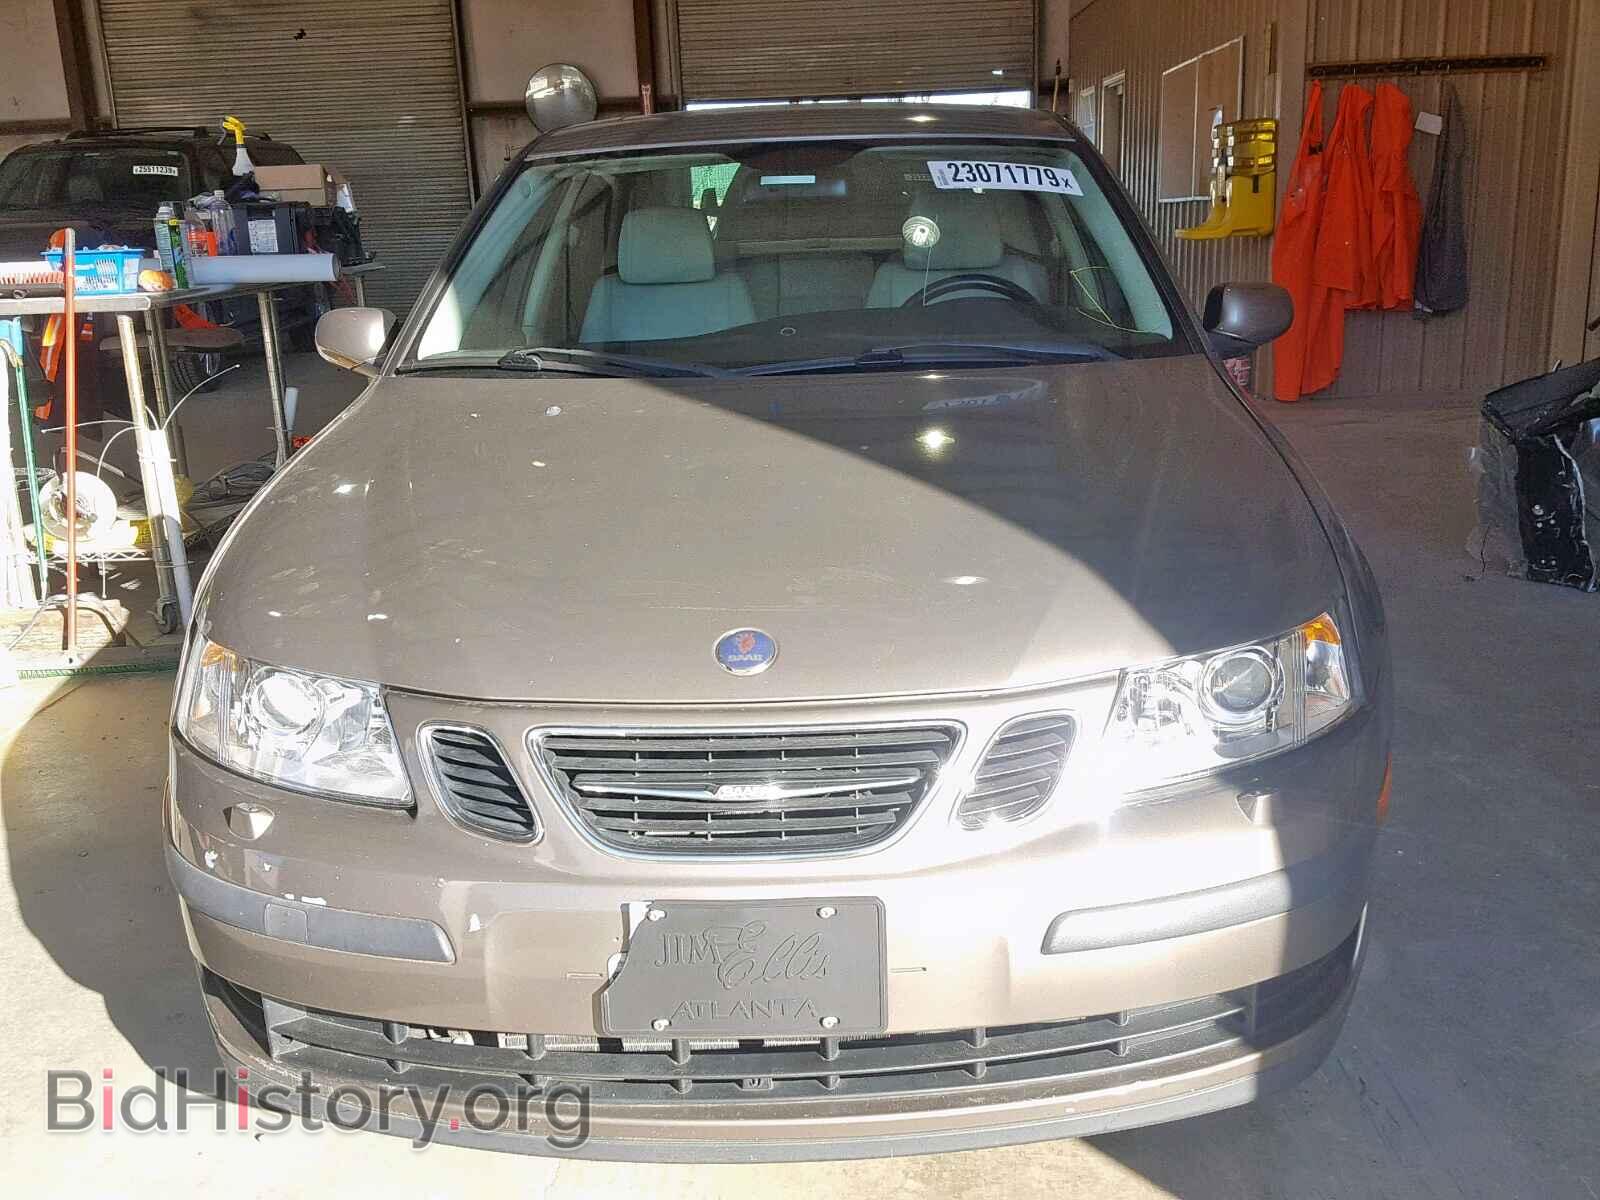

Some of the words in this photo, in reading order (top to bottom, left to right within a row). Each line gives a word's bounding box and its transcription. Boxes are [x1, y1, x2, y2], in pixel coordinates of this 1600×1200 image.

[947, 162, 1060, 187] 23071779
[654, 932, 721, 968] JIM
[704, 920, 831, 990] Ellis
[671, 999, 817, 1020] ATLANTA
